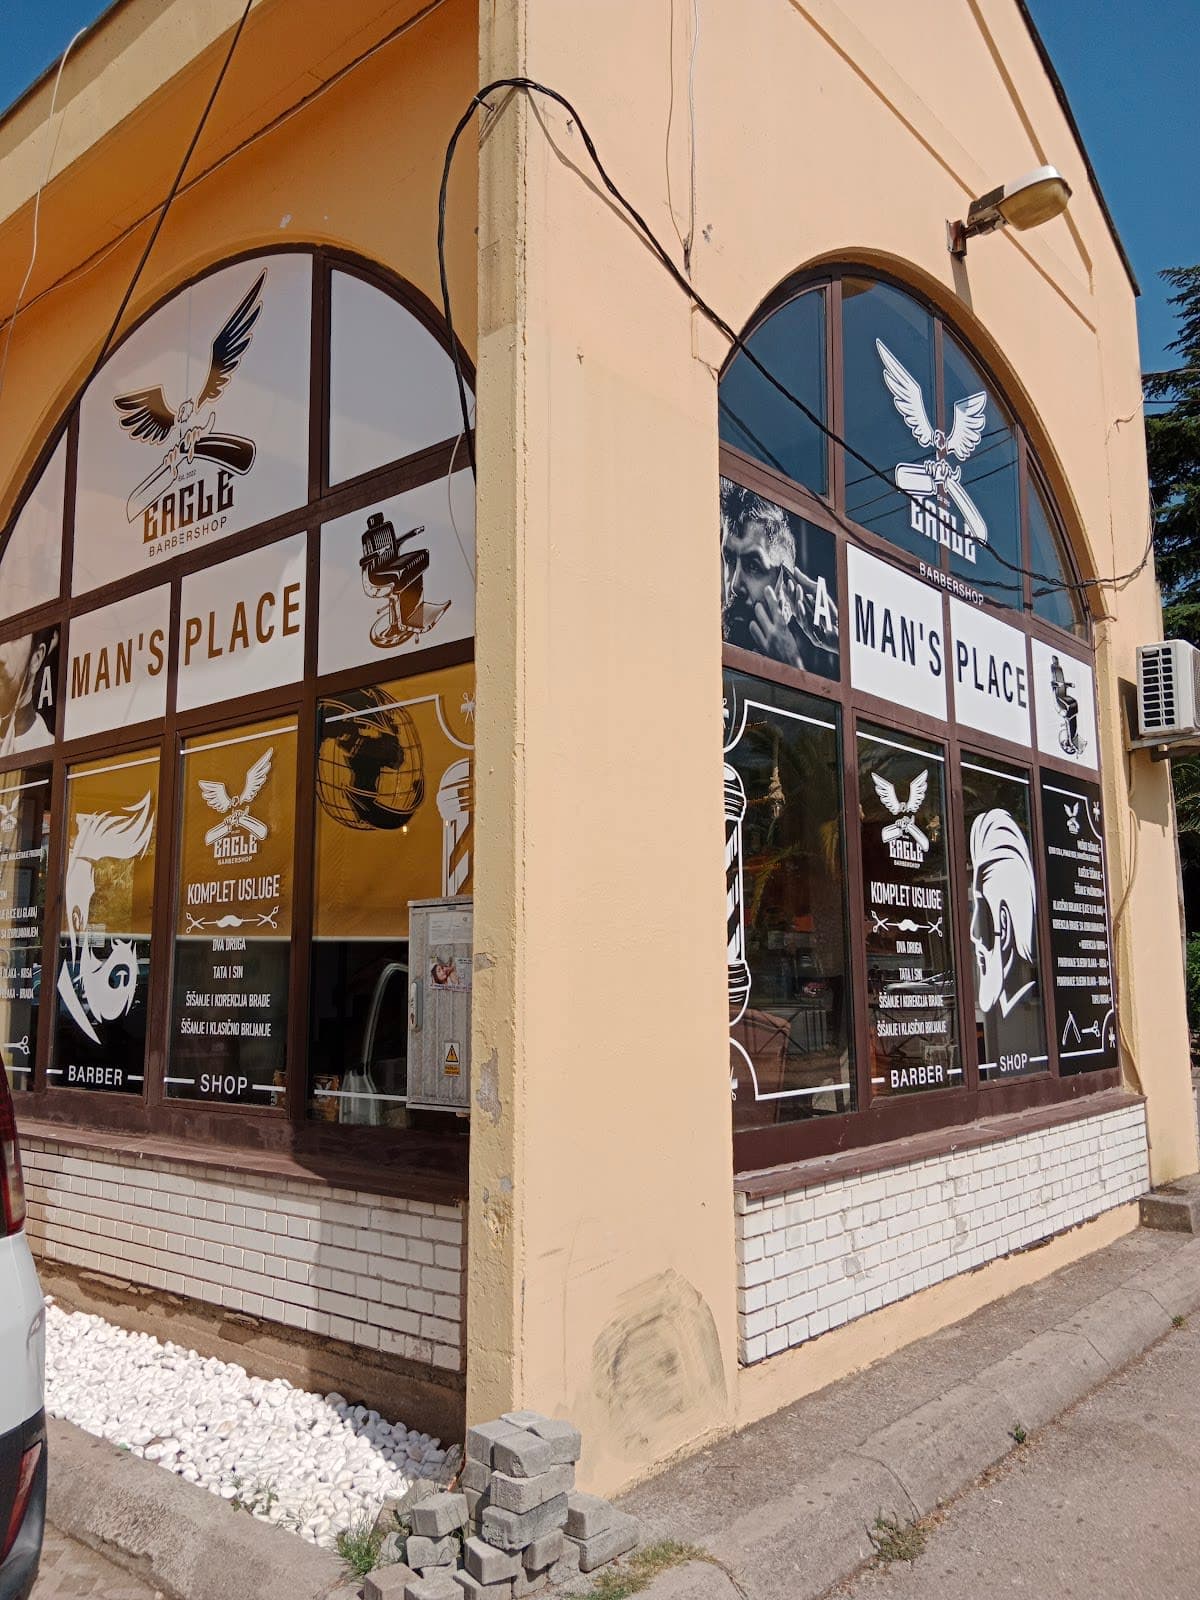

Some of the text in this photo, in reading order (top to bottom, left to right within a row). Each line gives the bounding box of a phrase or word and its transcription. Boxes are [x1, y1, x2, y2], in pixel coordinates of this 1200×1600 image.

[142, 468, 235, 544] EAGLE
[149, 516, 227, 557] BARBERSHOP
[910, 494, 976, 564] EAGLE
[919, 562, 984, 606] BARBERSHOP
[38, 582, 300, 710] A MAN'S PLACE
[813, 575, 1027, 709] A MAN'S PLACE
[214, 834, 257, 859] EAGLE
[889, 839, 924, 863] EAGLE
[187, 874, 280, 905] KOMPLET USLUGE
[870, 880, 942, 910] KOMPLET USLUGE
[212, 937, 247, 952] DVA DRUGA
[213, 966, 227, 979] TATA
[232, 965, 243, 979] SIN
[899, 968, 910, 981] TATA
[185, 991, 210, 1007] ŠIŠANJE
[214, 993, 248, 1007] KOREKCIJA
[249, 993, 270, 1008] BRADE
[181, 1018, 206, 1034] ŠIŠANJE
[210, 1019, 239, 1036] KLASIČNO
[68, 1064, 123, 1085] BARBER
[1000, 1053, 1028, 1072] SHOP
[200, 1073, 248, 1095] SHOP
[890, 1064, 943, 1089] BARBER
